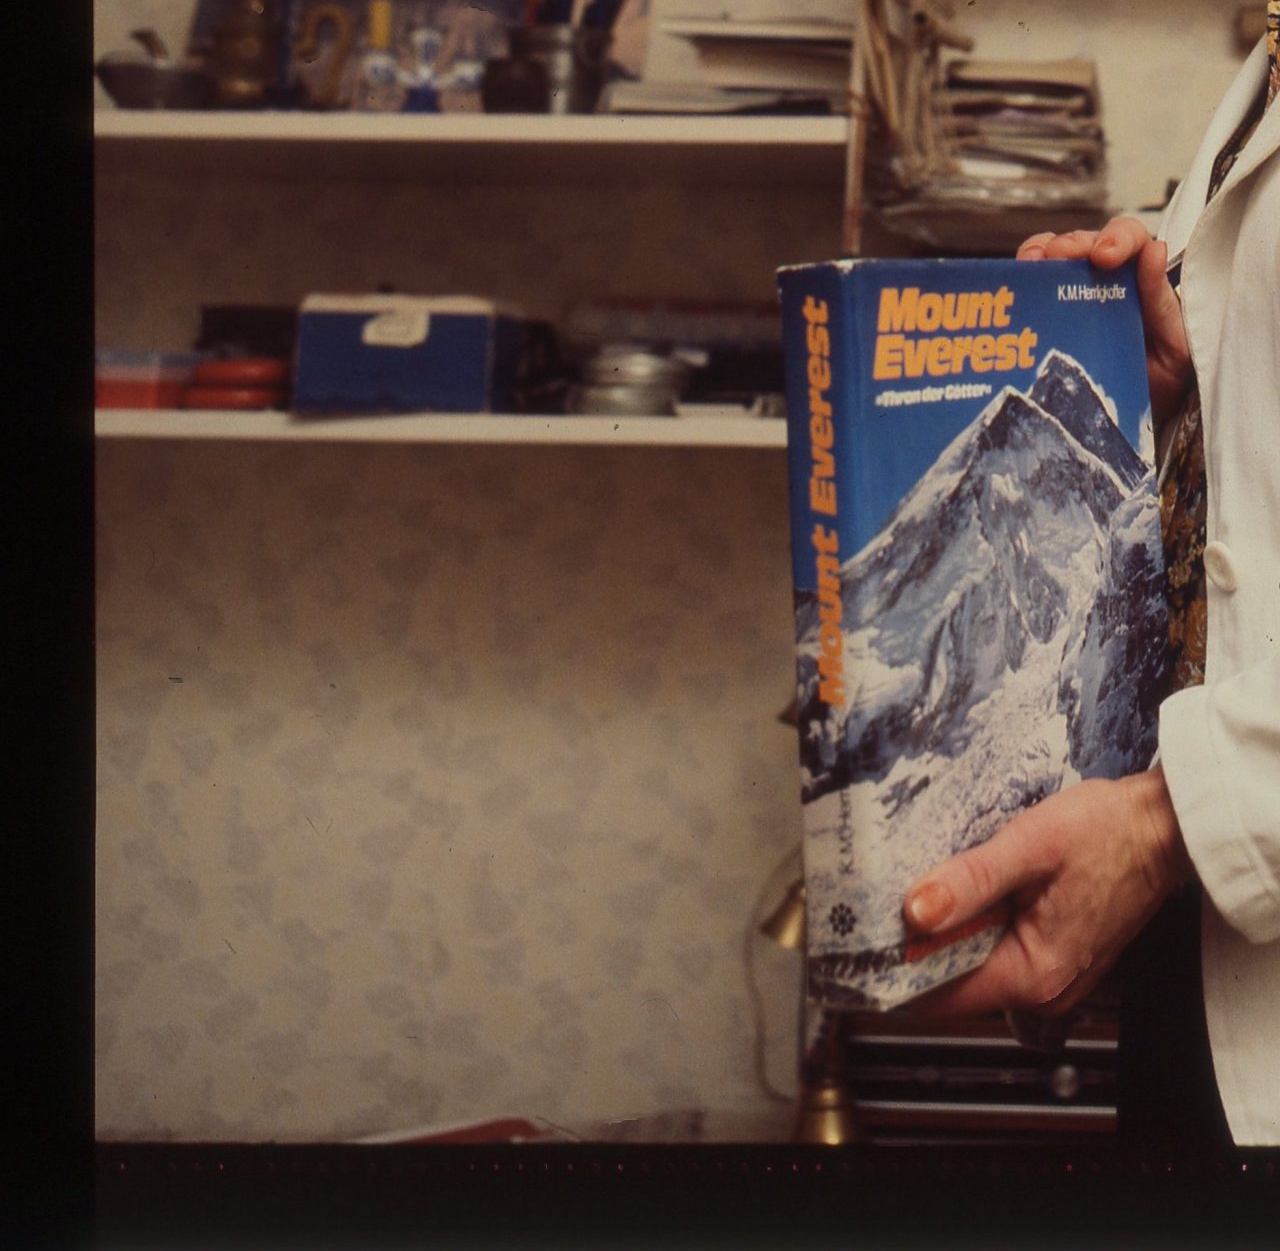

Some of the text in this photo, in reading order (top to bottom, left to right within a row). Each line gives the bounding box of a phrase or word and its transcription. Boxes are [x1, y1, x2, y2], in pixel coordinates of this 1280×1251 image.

[877, 285, 1014, 334] Mount
[873, 326, 1038, 381] Everest
[802, 295, 846, 710] Mount Everest
